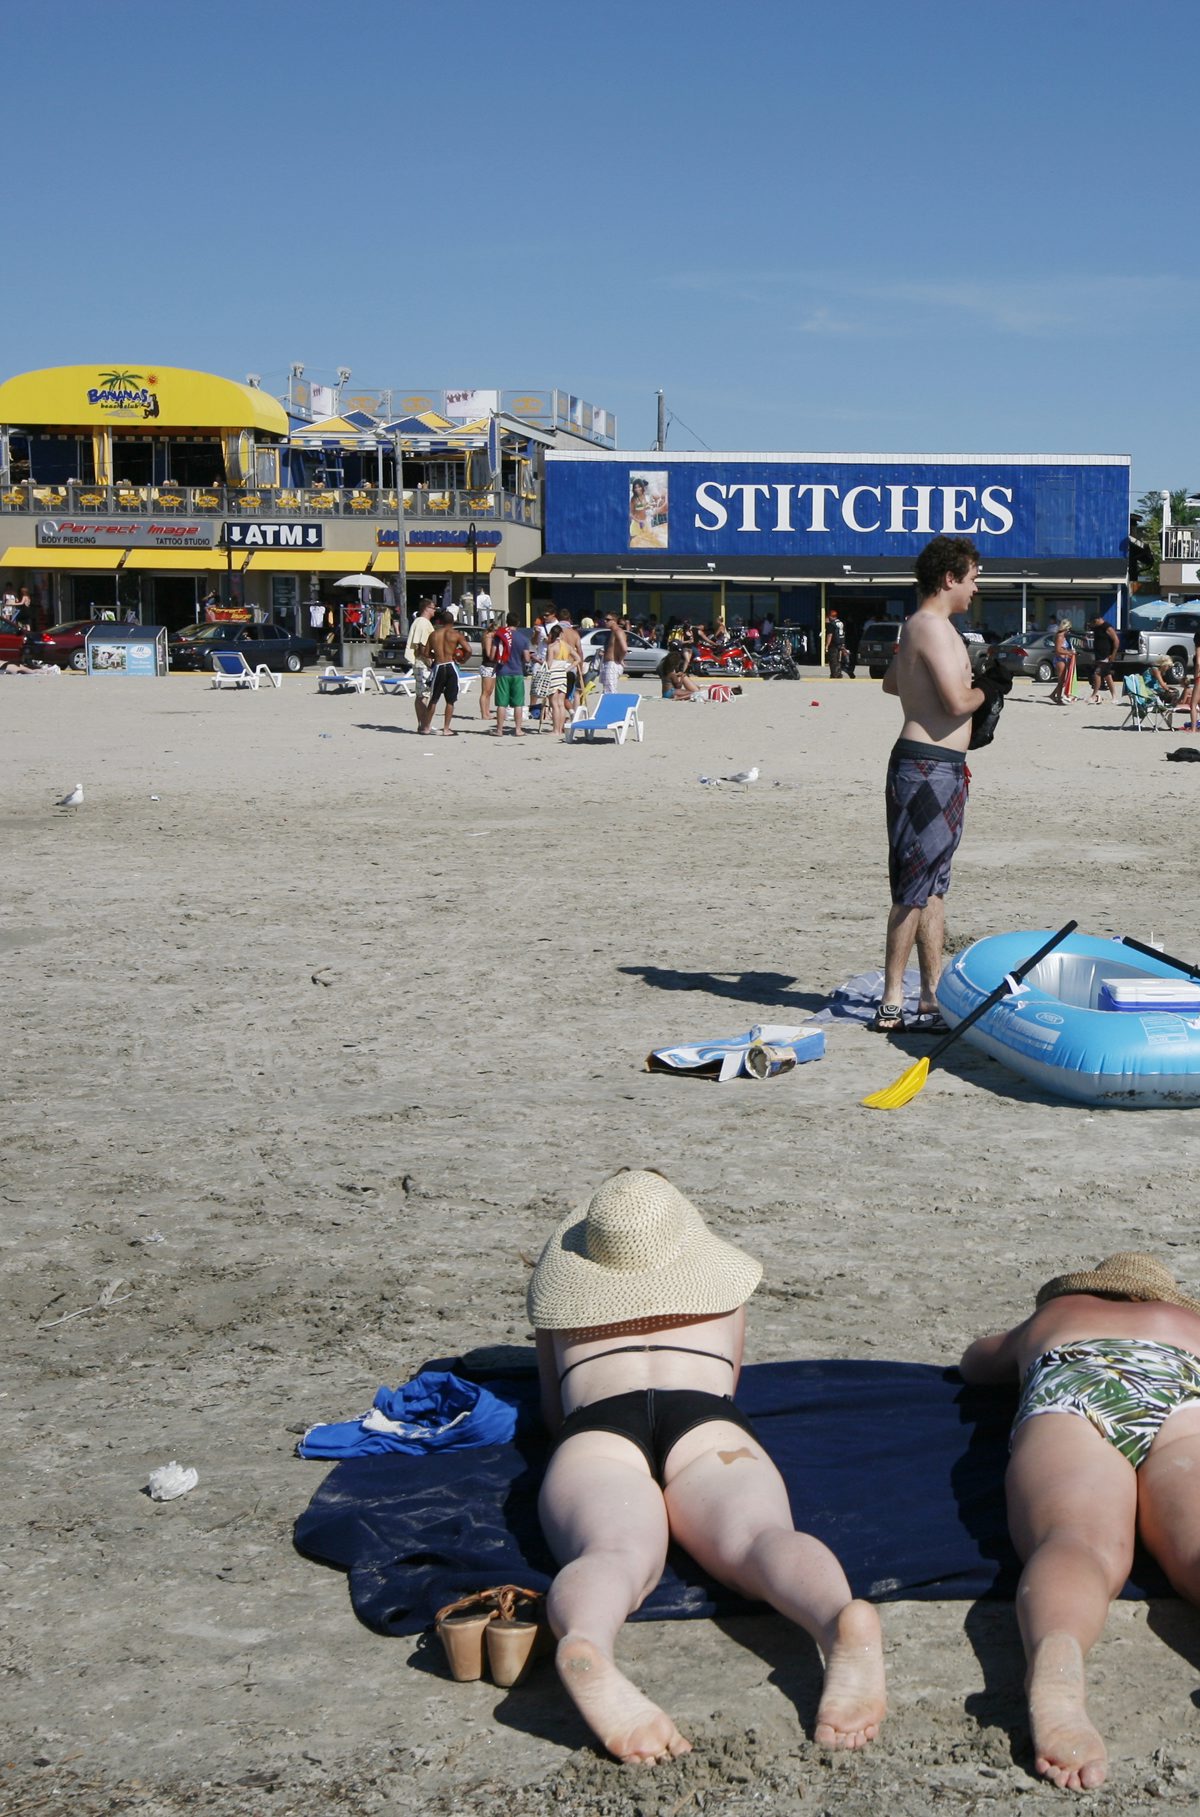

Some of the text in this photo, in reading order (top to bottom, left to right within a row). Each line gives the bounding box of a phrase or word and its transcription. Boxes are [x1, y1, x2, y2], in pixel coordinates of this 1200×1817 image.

[87, 389, 149, 404] BANANAS
[694, 481, 1014, 535] STITCHES
[147, 524, 200, 537] Image
[245, 524, 303, 546] ATM
[41, 536, 96, 545] BODY PIERCING
[155, 537, 210, 546] TATTOO STUDIO
